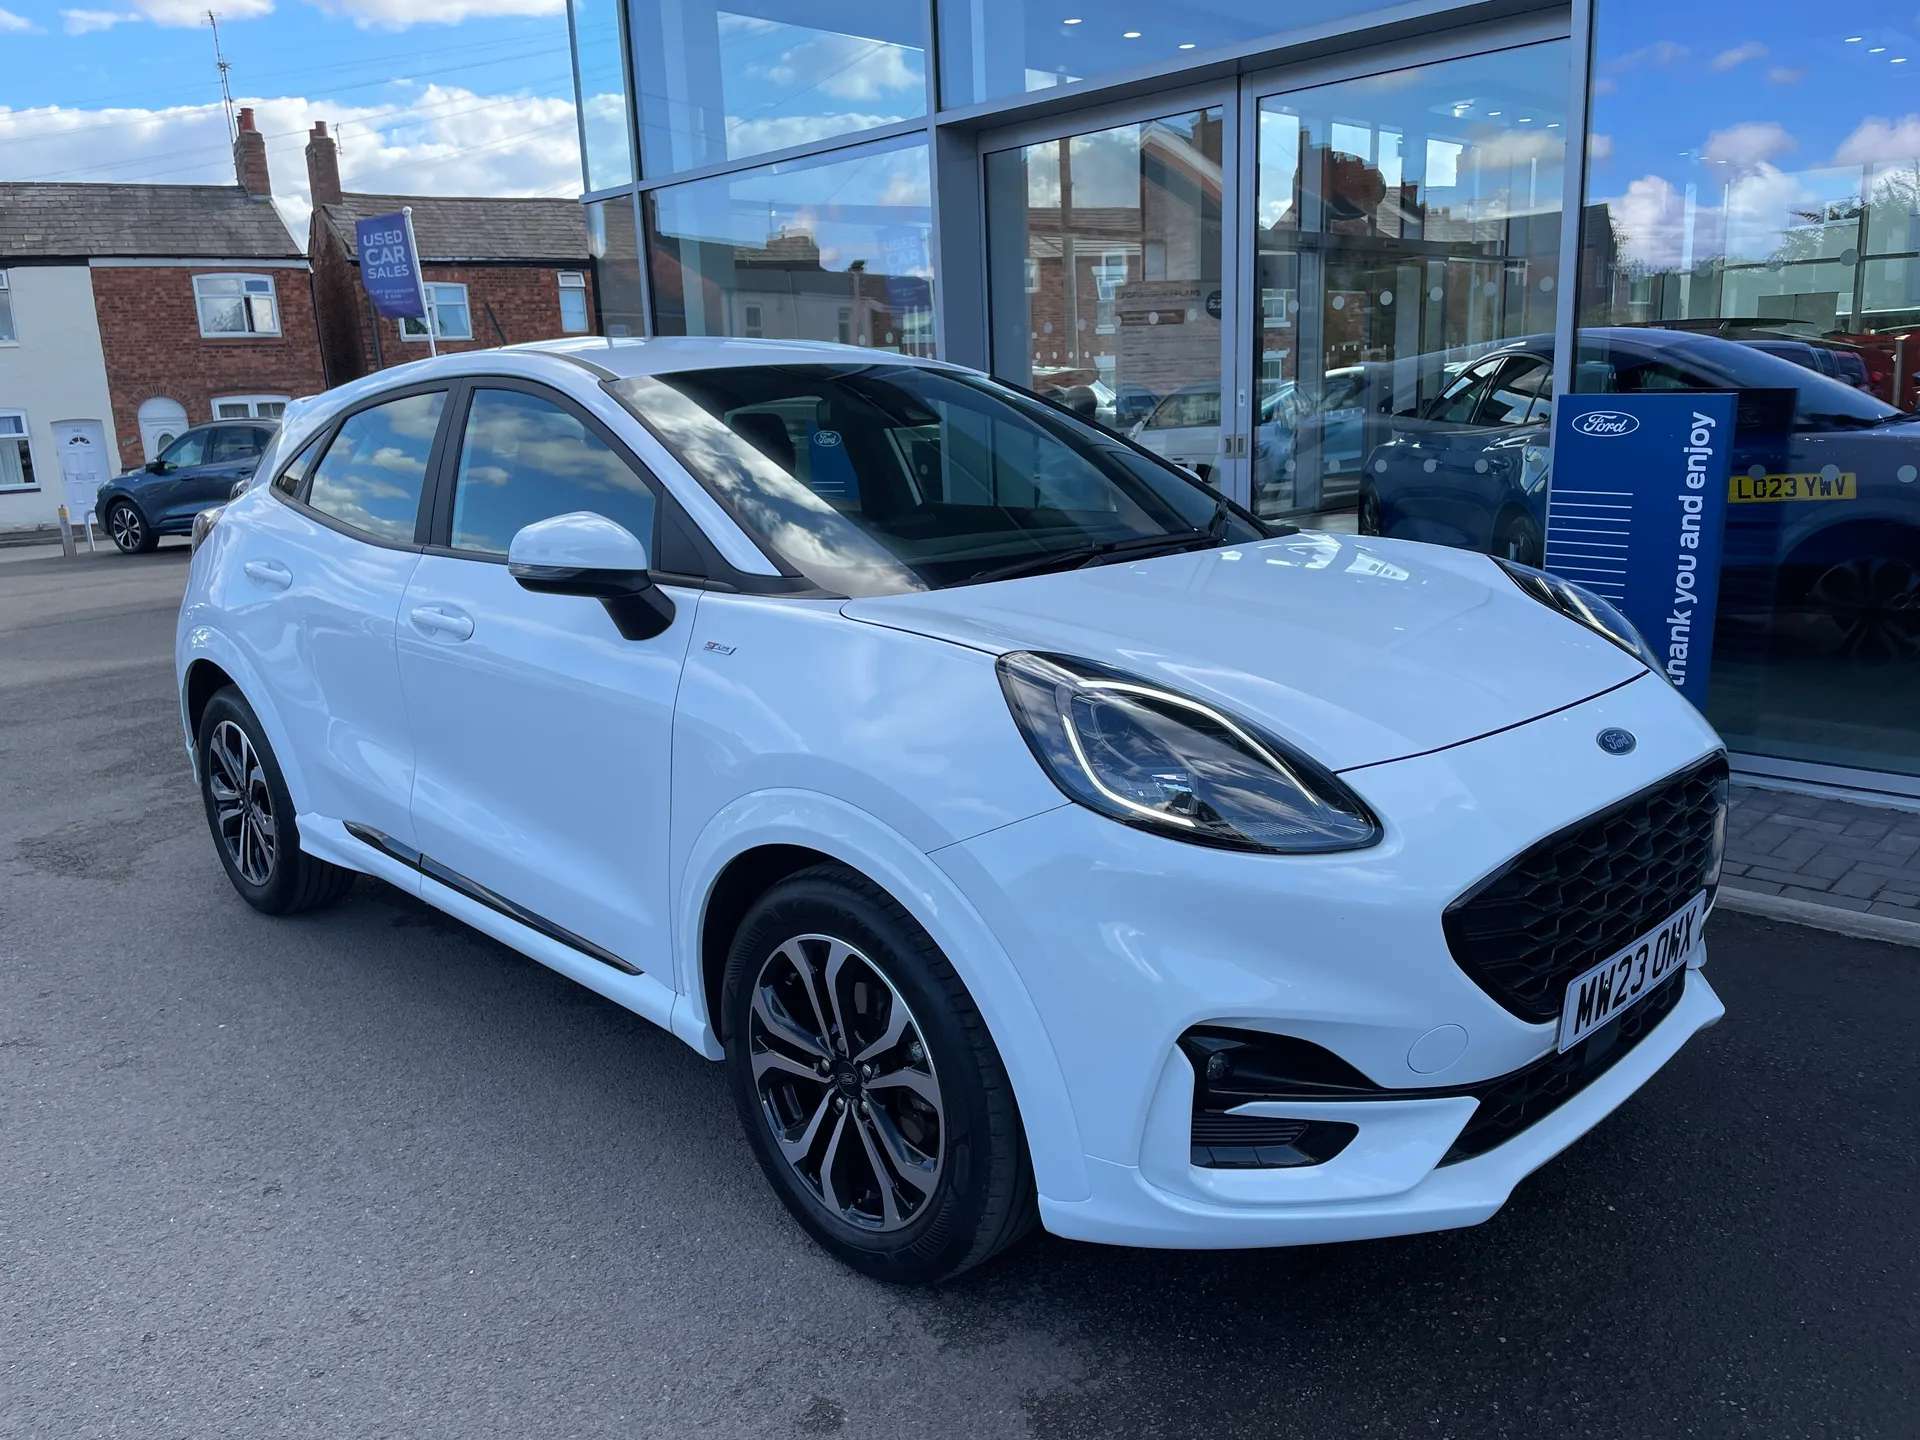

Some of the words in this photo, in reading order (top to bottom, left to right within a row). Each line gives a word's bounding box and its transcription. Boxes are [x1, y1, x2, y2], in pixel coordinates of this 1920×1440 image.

[363, 229, 403, 247] USED
[364, 245, 406, 266] CAR
[367, 264, 410, 279] SALES
[1583, 413, 1627, 433] Ford
[1684, 411, 1716, 490] enjoy
[1804, 476, 1846, 497] YWV
[1678, 495, 1704, 549] and
[1674, 554, 1698, 605] you
[1574, 943, 1650, 1035] MW23
[1652, 905, 1697, 979] OMX
